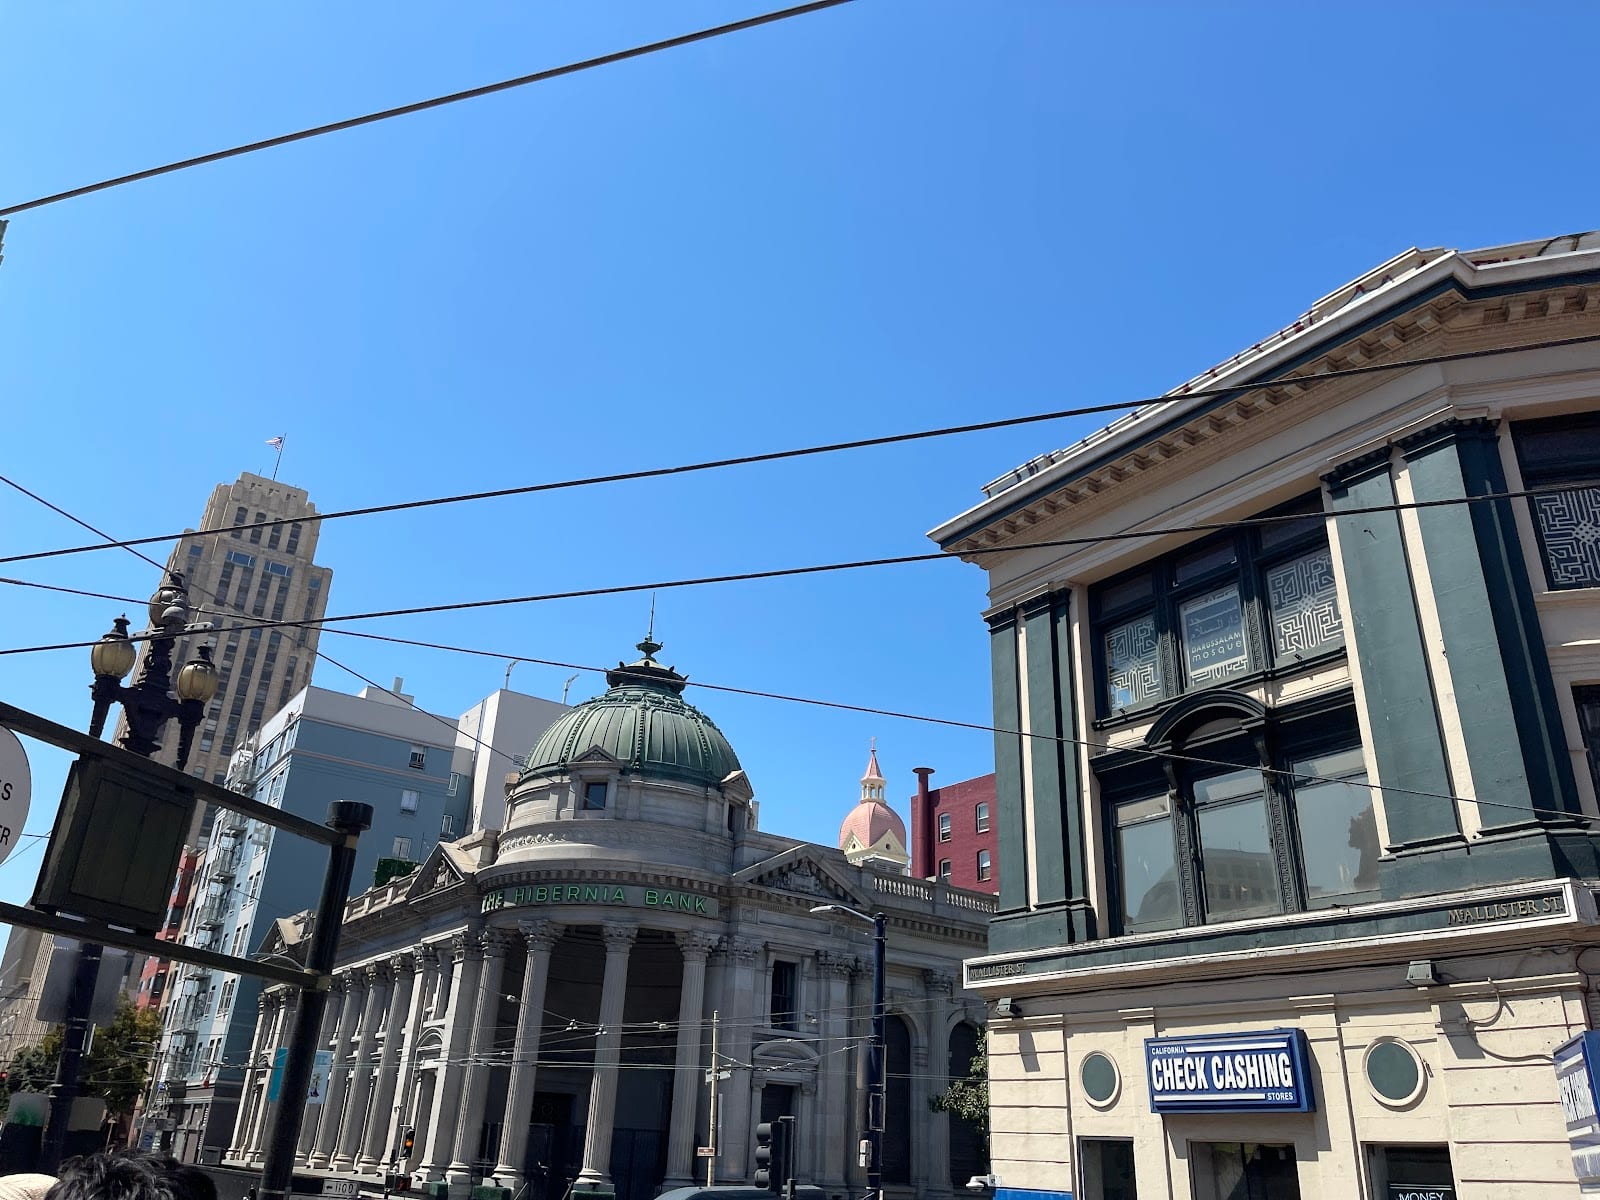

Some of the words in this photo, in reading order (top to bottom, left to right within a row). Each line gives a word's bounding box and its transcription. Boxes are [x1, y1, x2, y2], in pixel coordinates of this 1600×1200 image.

[1191, 632, 1241, 654] DARUSSALAM
[1192, 640, 1242, 662] mosque
[480, 891, 504, 914] THE
[514, 885, 625, 902] HIBERNIA
[645, 890, 707, 914] BANK
[1151, 1046, 1185, 1055] CALIFORNIA
[1151, 1056, 1209, 1091] CHECK
[1211, 1052, 1294, 1090] CASHING
[1267, 1092, 1294, 1101] STORES
[1398, 1192, 1444, 1200] MONEY
